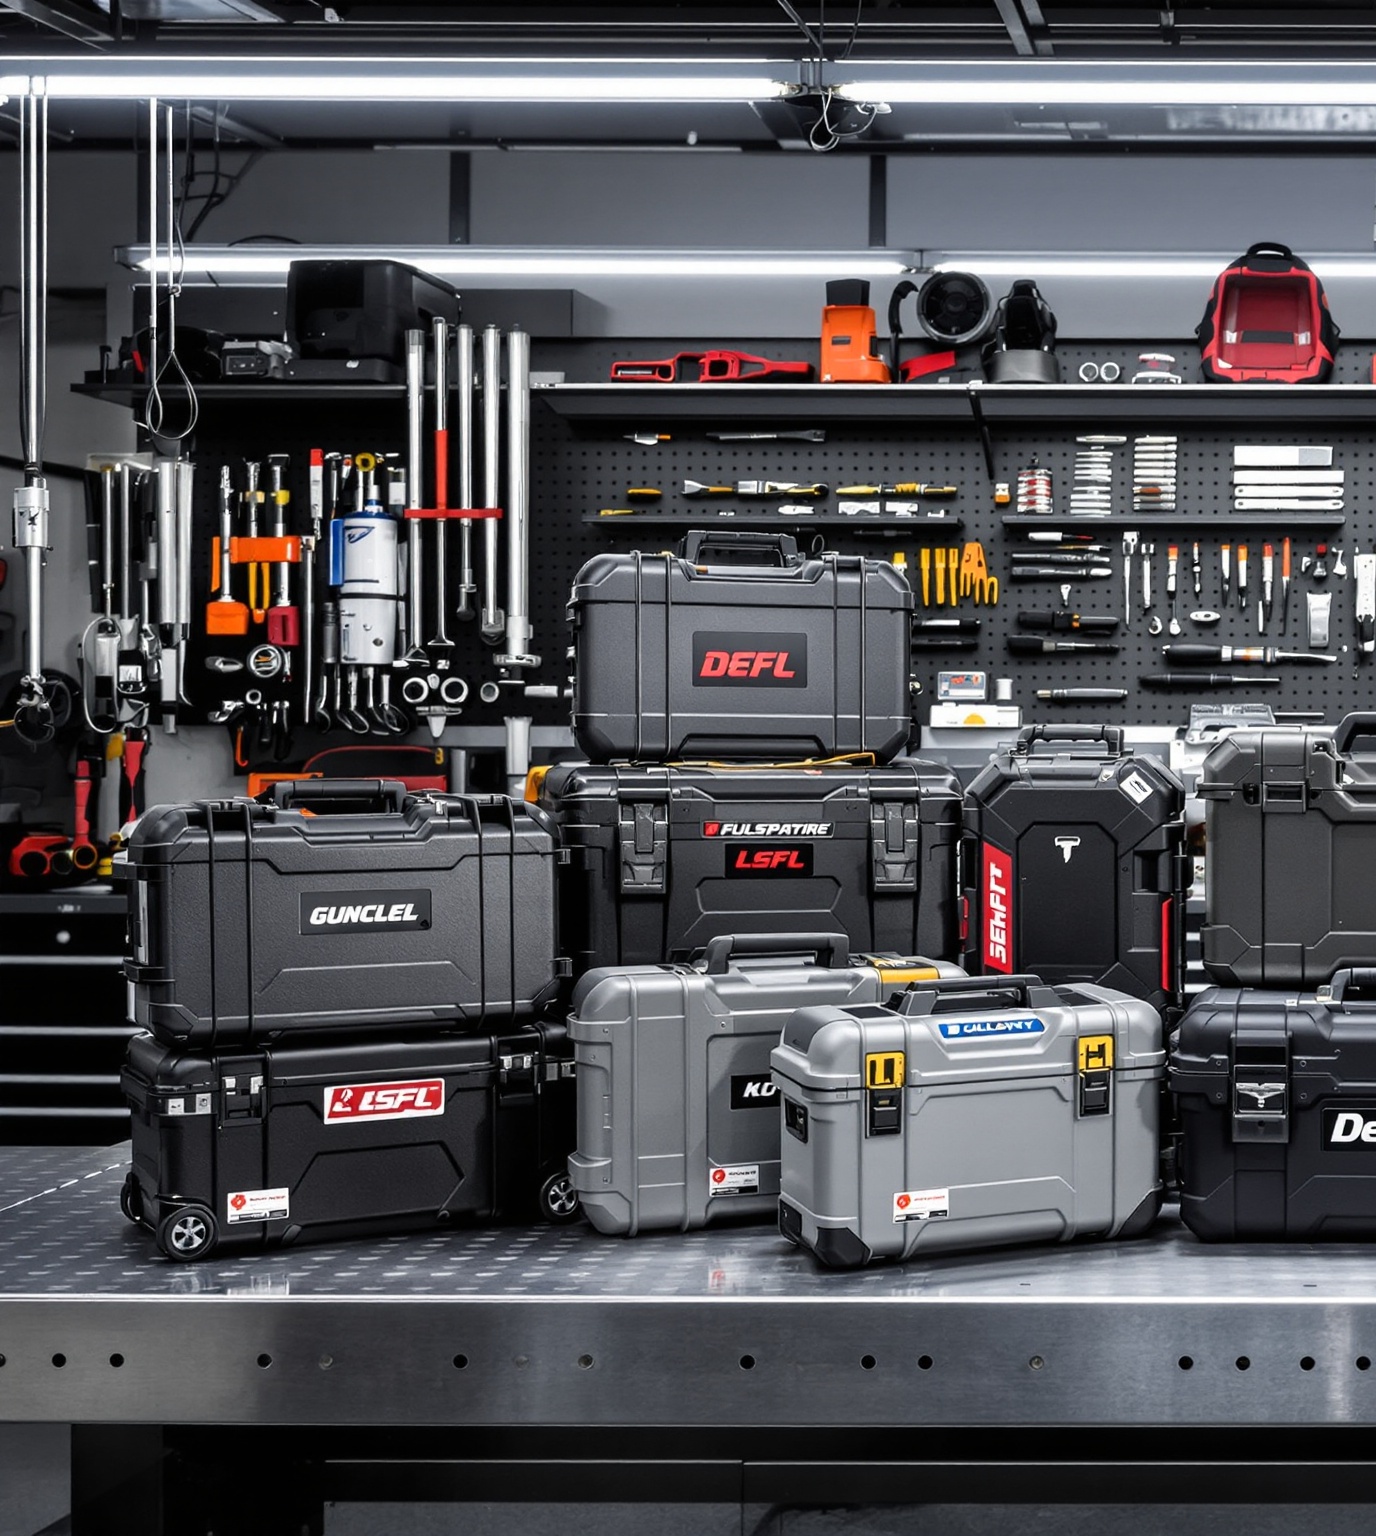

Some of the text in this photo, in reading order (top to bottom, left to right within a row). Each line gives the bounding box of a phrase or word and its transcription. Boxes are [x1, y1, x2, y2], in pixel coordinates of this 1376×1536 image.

[700, 651, 796, 678] DEFL
[735, 850, 804, 869] LSFL
[309, 903, 419, 925] GUNCLEL
